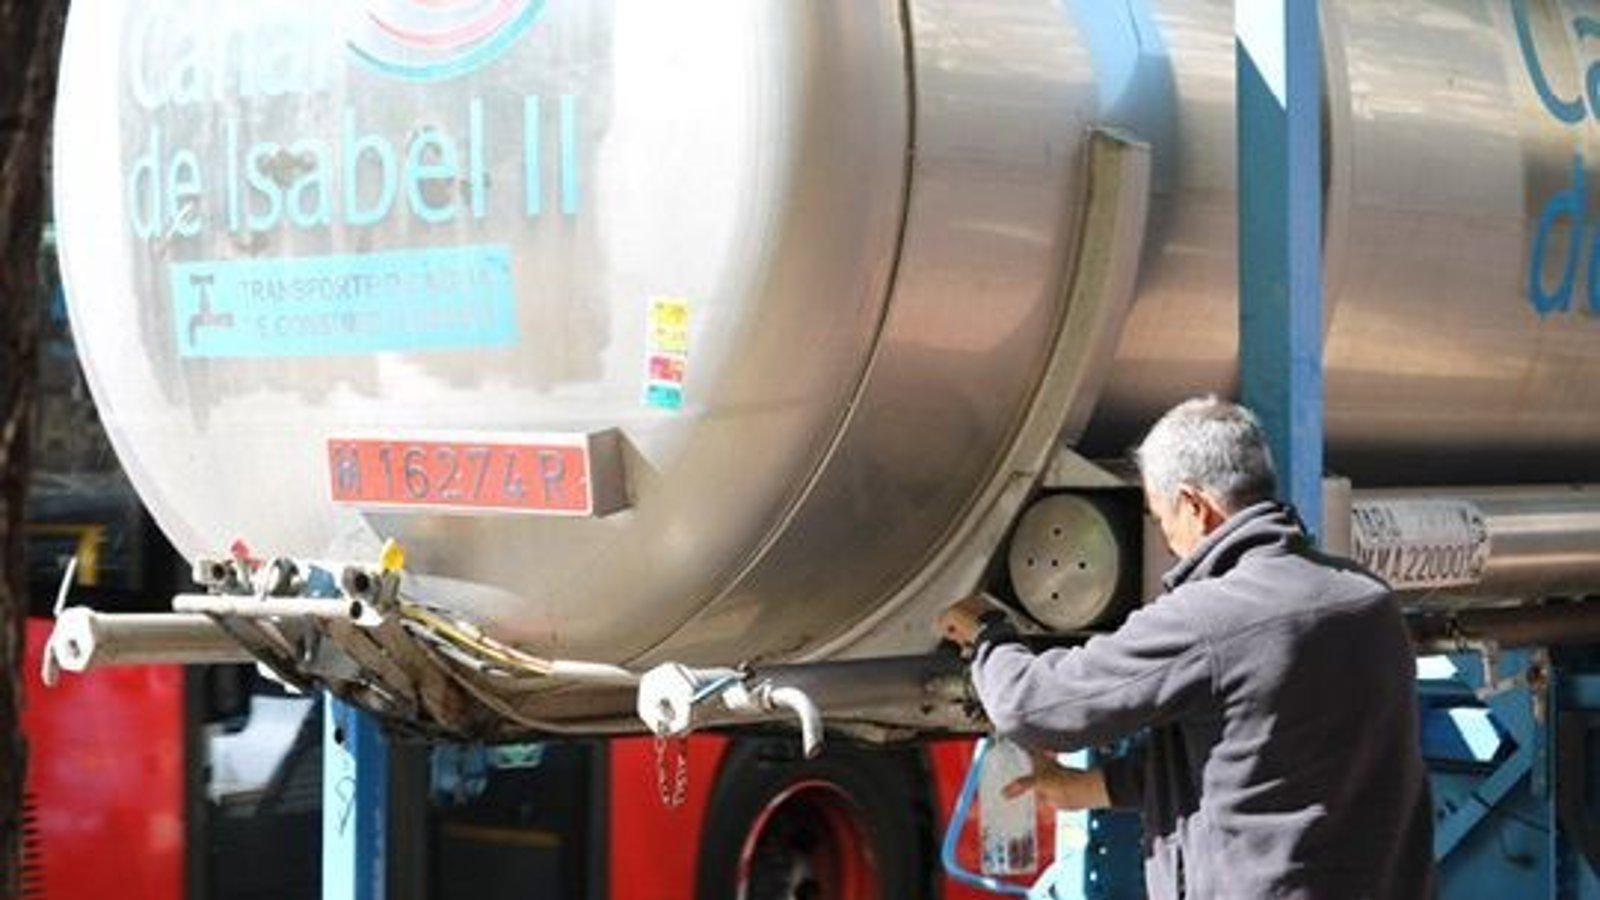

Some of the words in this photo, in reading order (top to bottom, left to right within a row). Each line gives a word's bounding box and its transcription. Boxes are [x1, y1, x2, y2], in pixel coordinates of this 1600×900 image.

[130, 122, 203, 239] de
[227, 98, 485, 232] Isabel
[524, 94, 577, 215] II
